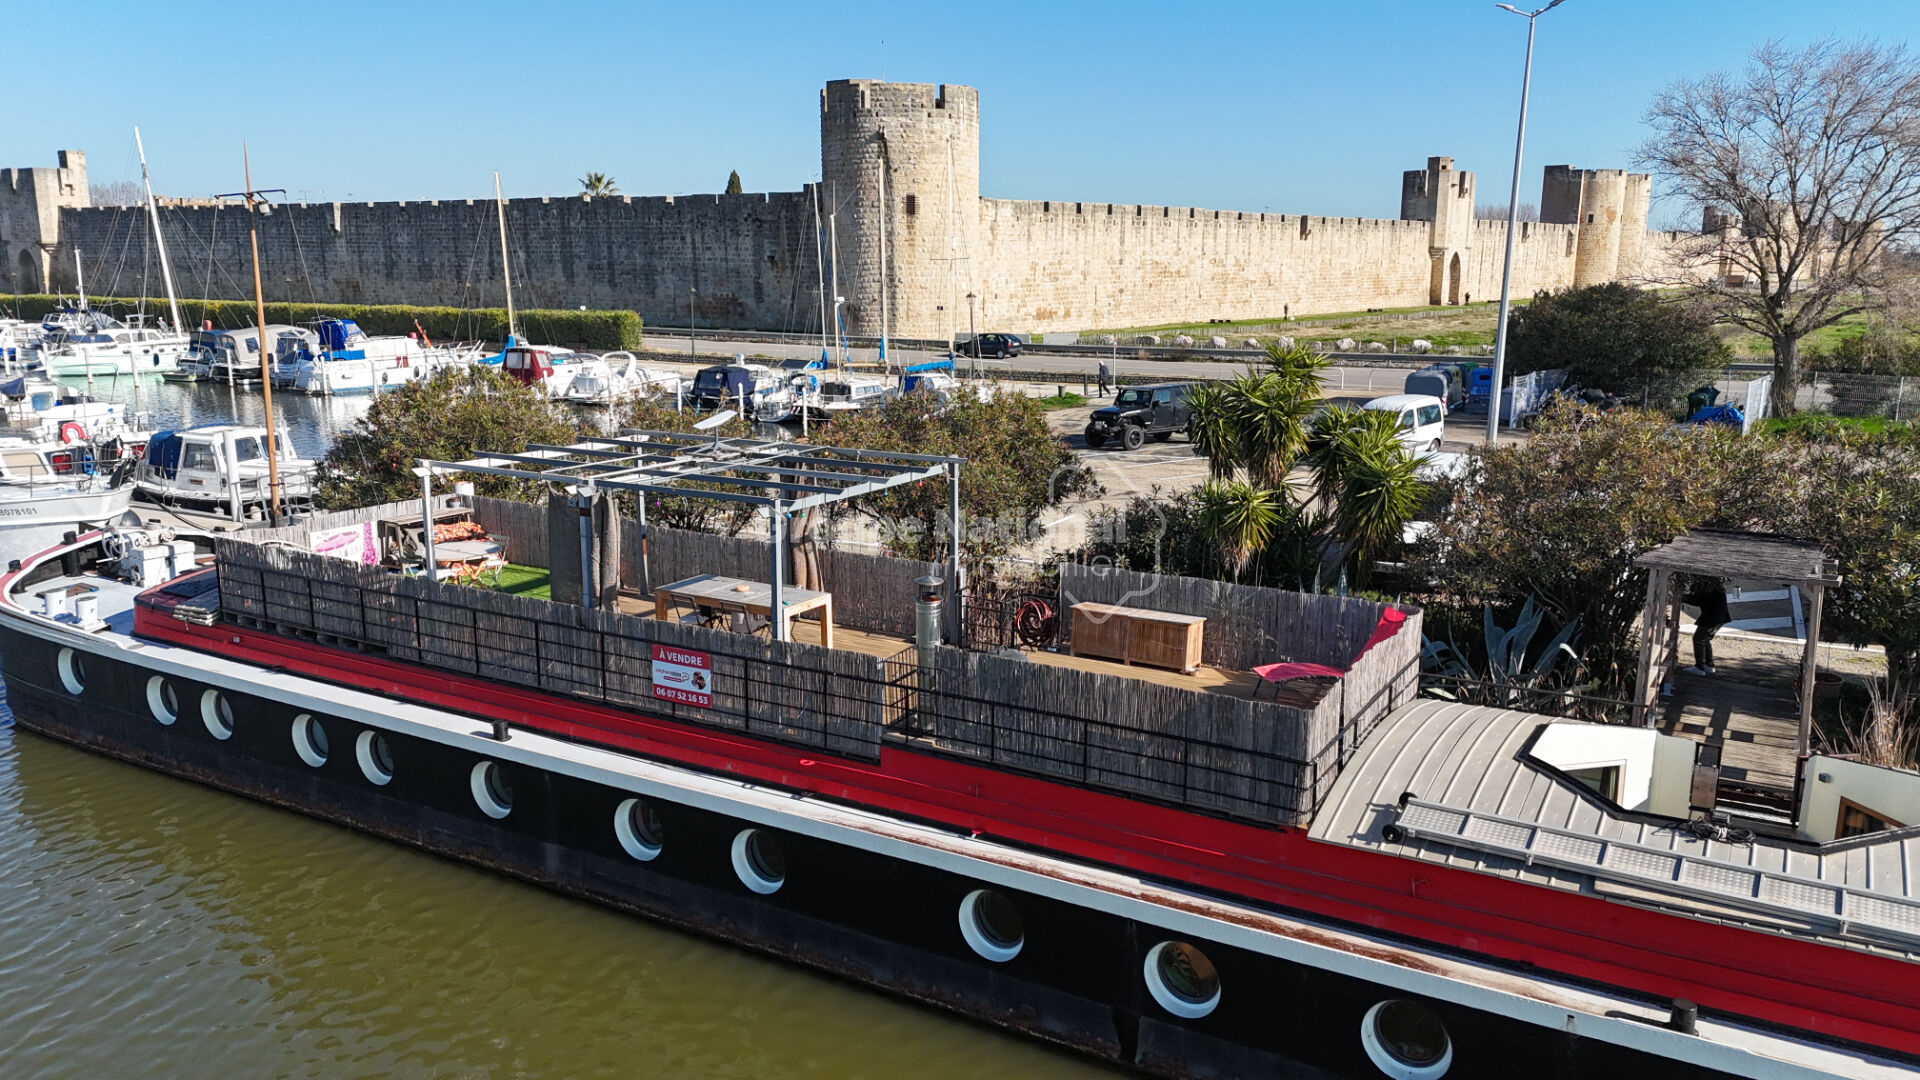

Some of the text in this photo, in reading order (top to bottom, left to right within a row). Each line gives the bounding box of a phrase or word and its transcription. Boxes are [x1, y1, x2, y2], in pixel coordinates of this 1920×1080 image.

[659, 648, 702, 666] À VENDRE
[656, 687, 708, 705] 06 07 52 16 53
